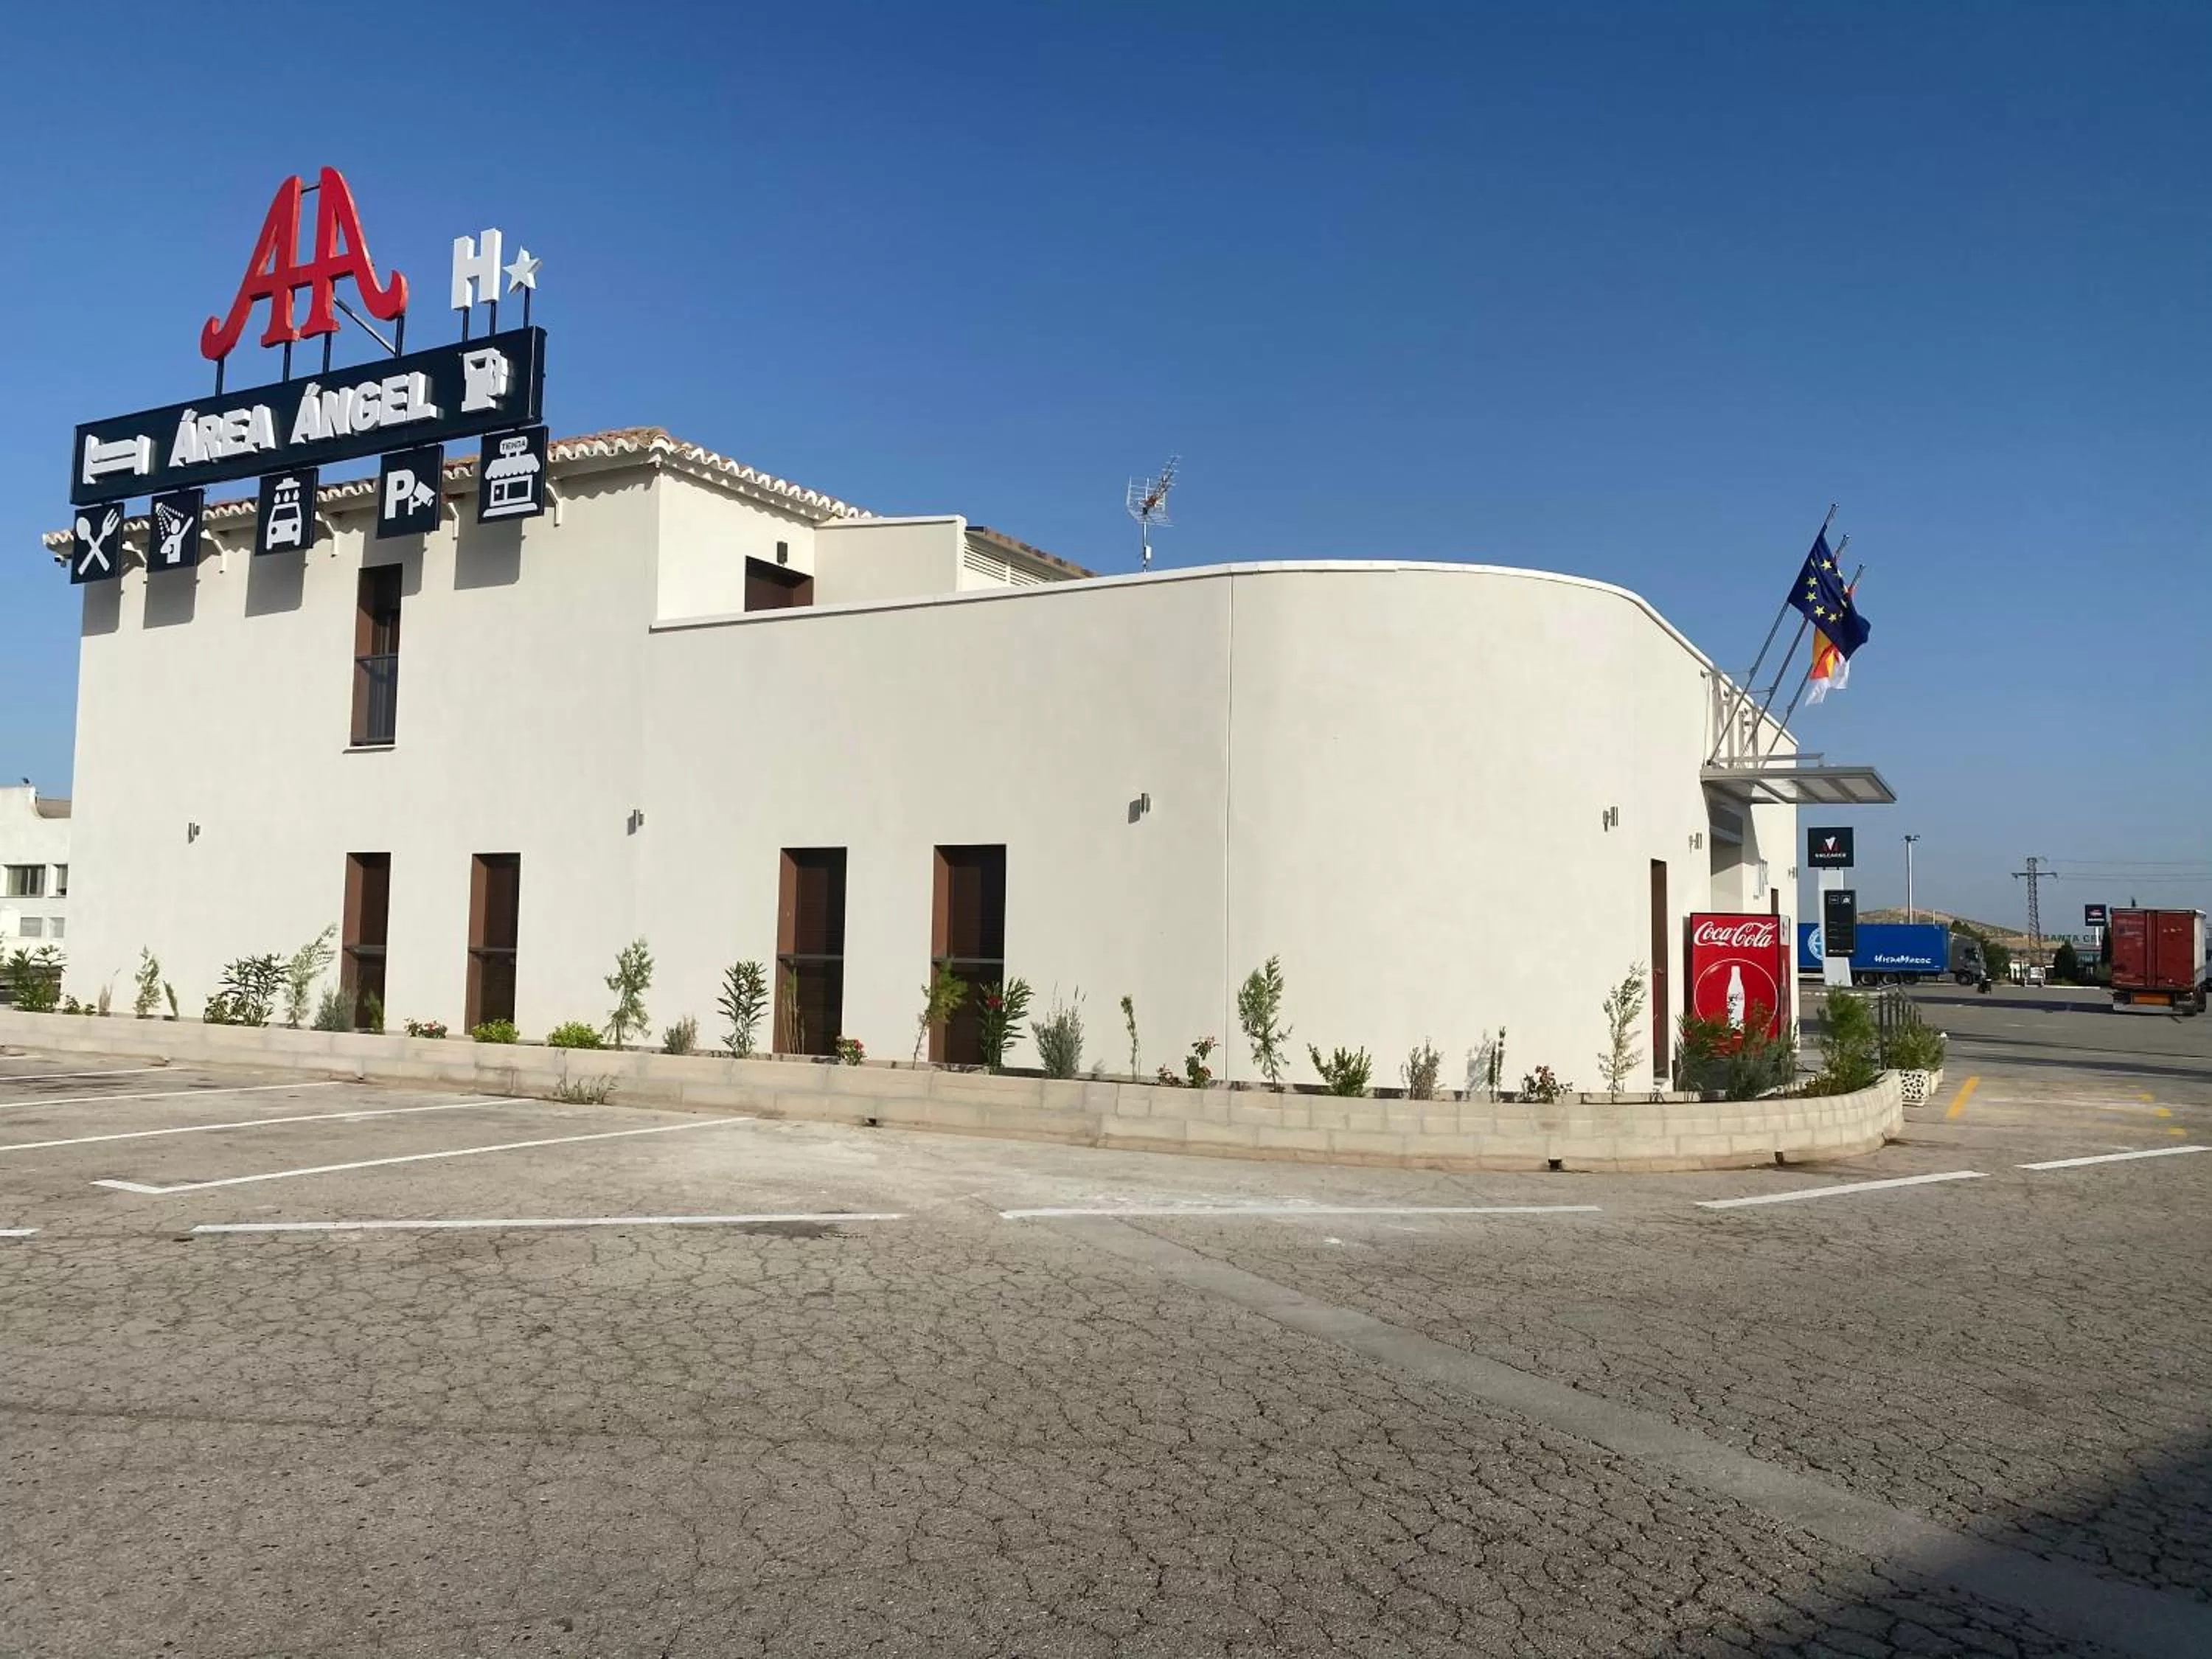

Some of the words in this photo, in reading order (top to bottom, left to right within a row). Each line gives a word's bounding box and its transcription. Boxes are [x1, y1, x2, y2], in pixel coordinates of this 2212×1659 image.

[451, 227, 503, 310] H
[168, 404, 276, 467] ÁREA
[290, 371, 438, 444] ÁNGEL
[384, 469, 416, 520] P
[1694, 921, 1778, 948] Coca-Cola
[2043, 934, 2079, 942] SANTA
